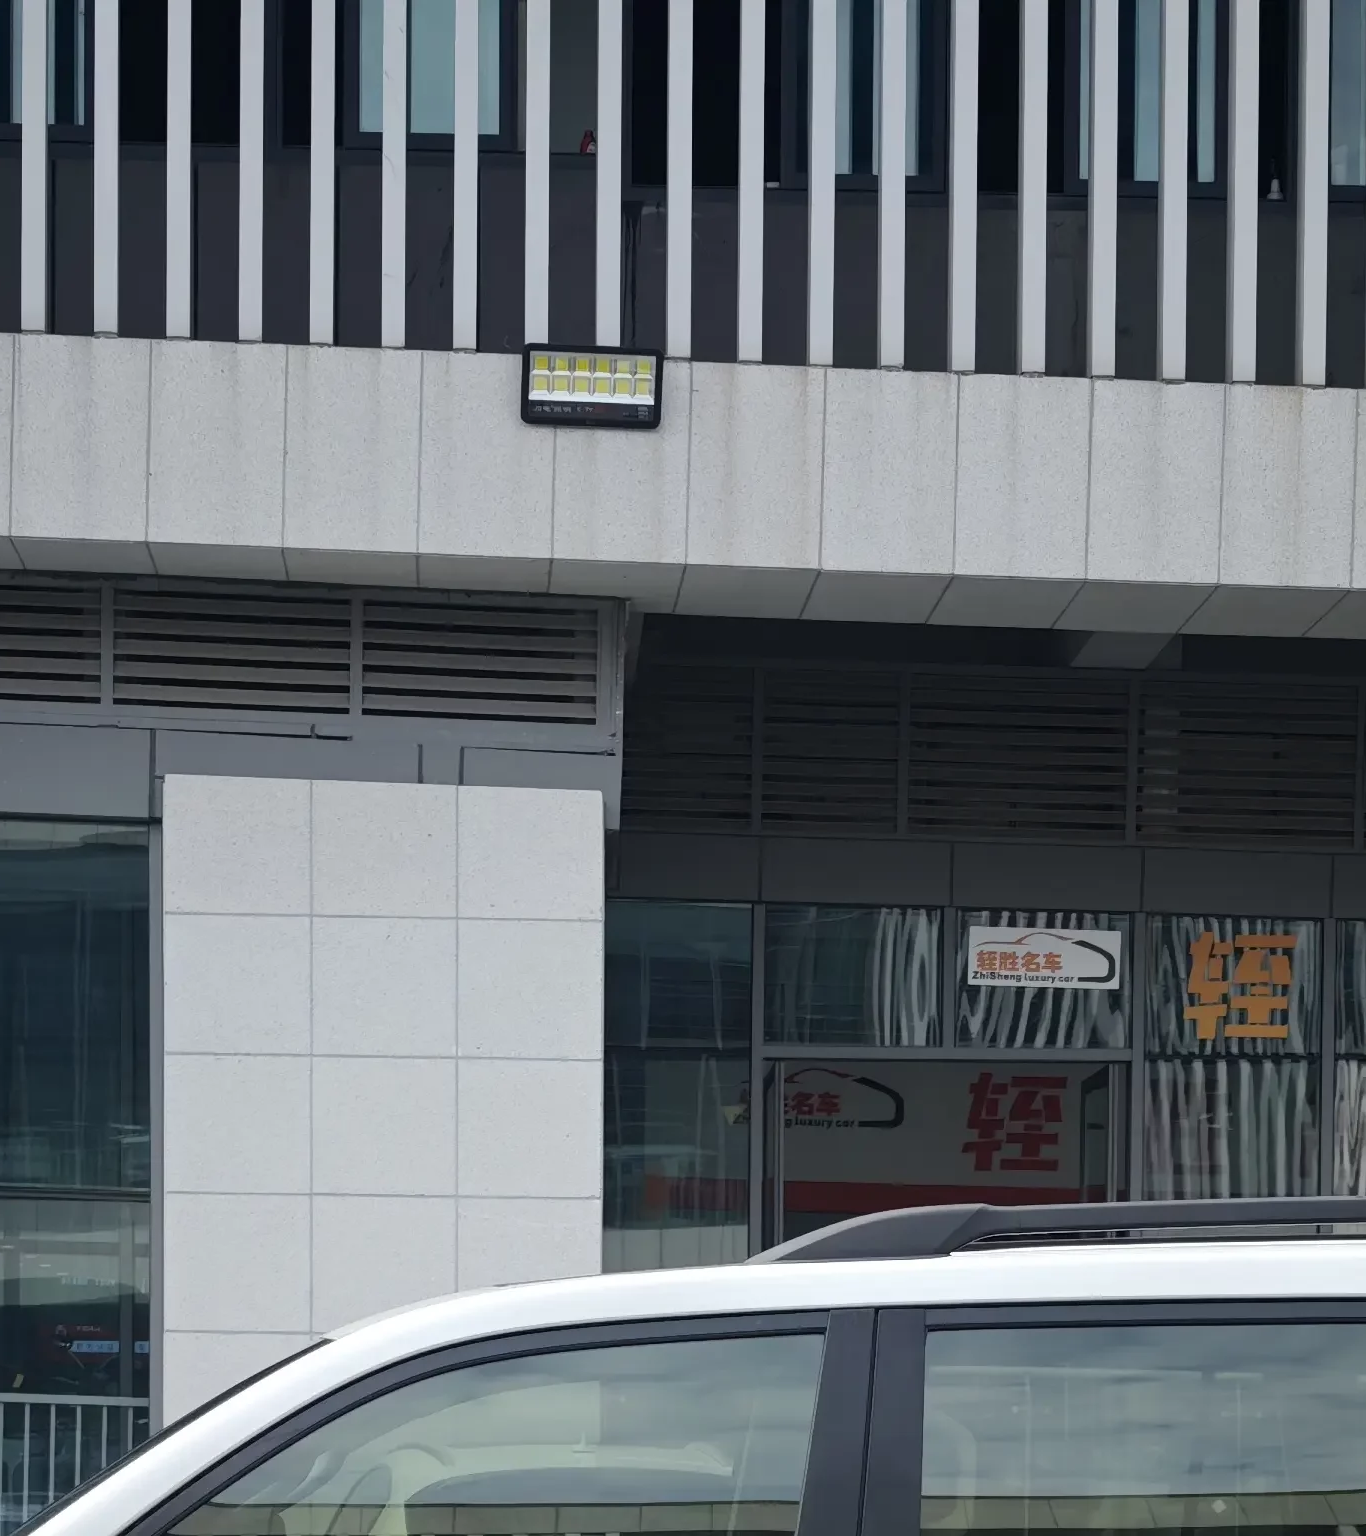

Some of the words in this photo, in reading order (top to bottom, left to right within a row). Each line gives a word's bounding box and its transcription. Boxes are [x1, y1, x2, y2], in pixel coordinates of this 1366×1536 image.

[976, 949, 1063, 973] 轾胜名车
[971, 971, 1022, 983] ZhiSheng
[1024, 972, 1056, 984] luxury
[795, 1115, 833, 1130] luxury
